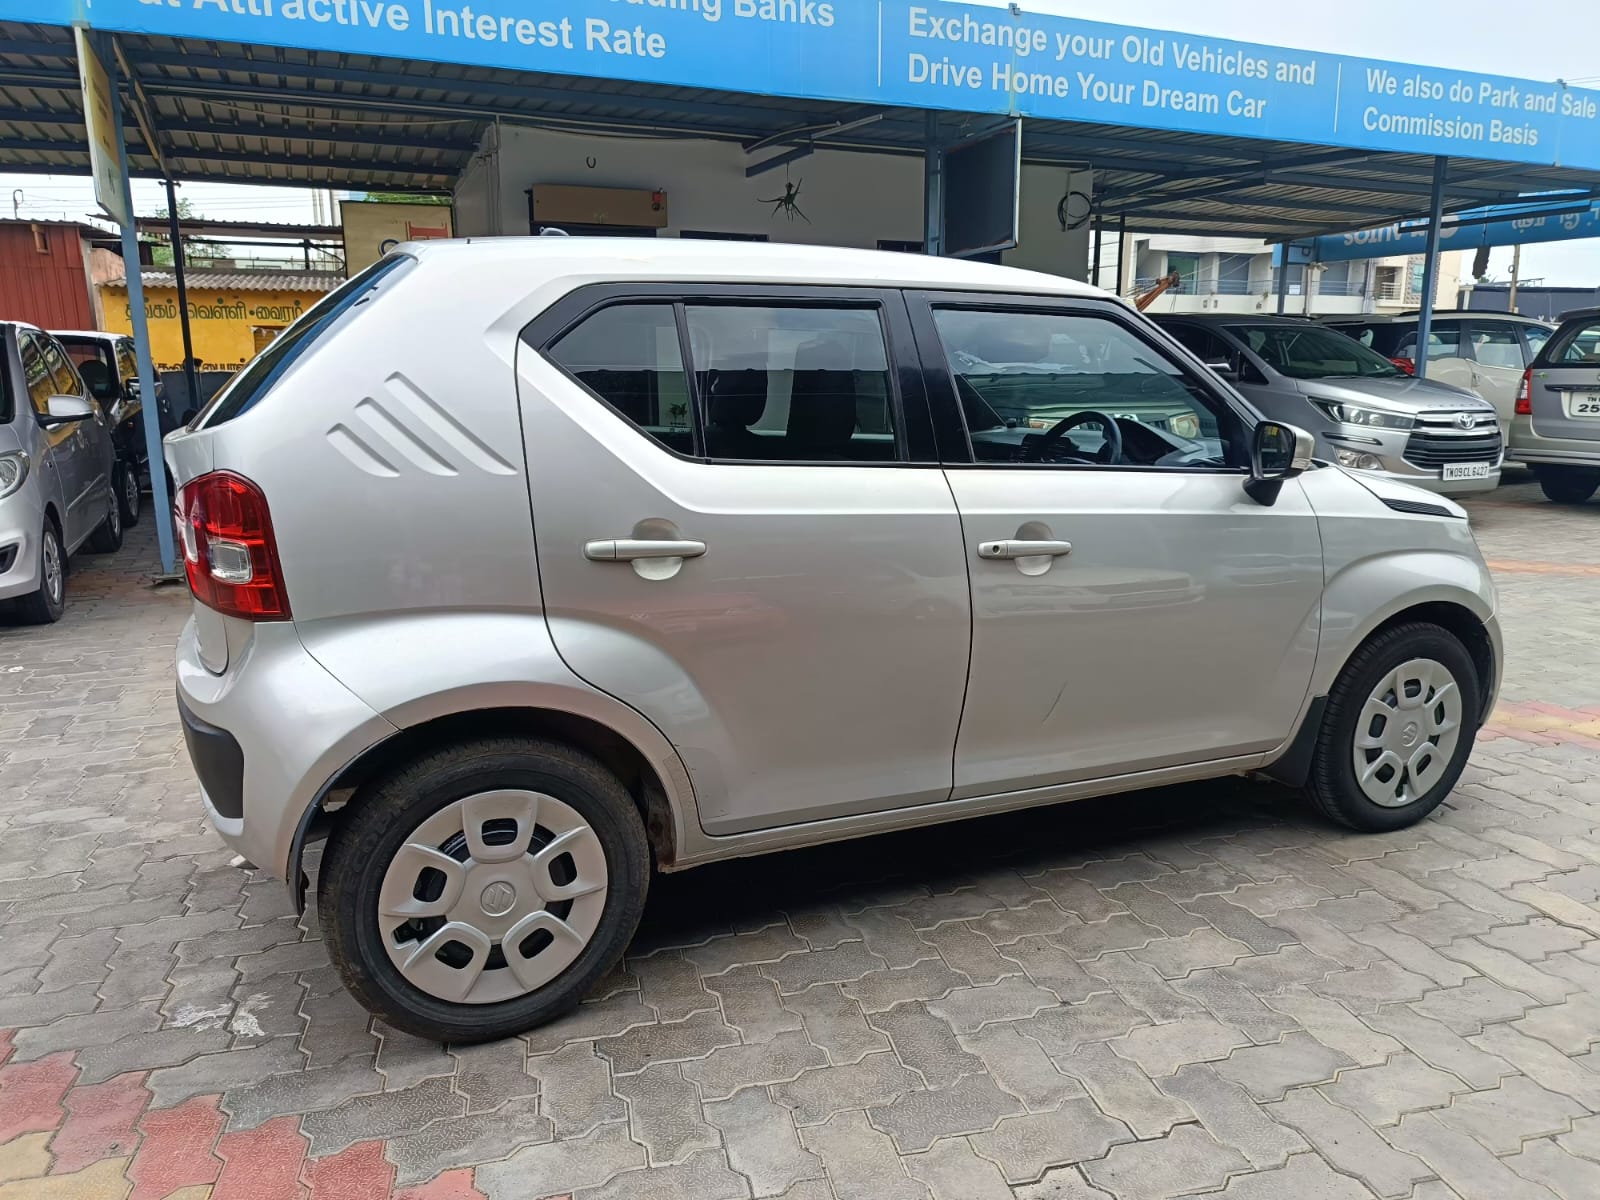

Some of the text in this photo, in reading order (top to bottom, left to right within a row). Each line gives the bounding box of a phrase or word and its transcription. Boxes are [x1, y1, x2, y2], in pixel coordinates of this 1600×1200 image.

[192, 0, 410, 31] ractive
[423, 0, 574, 49] Interest
[585, 17, 666, 58] Rate
[734, 0, 835, 27] Banks
[908, 6, 1317, 86] Exchange your Old Vehicles and
[908, 53, 1268, 119] Drive Home Your Dream Car
[1366, 67, 1598, 120] We also do Park and Sale
[1363, 106, 1539, 146] Commission Basis
